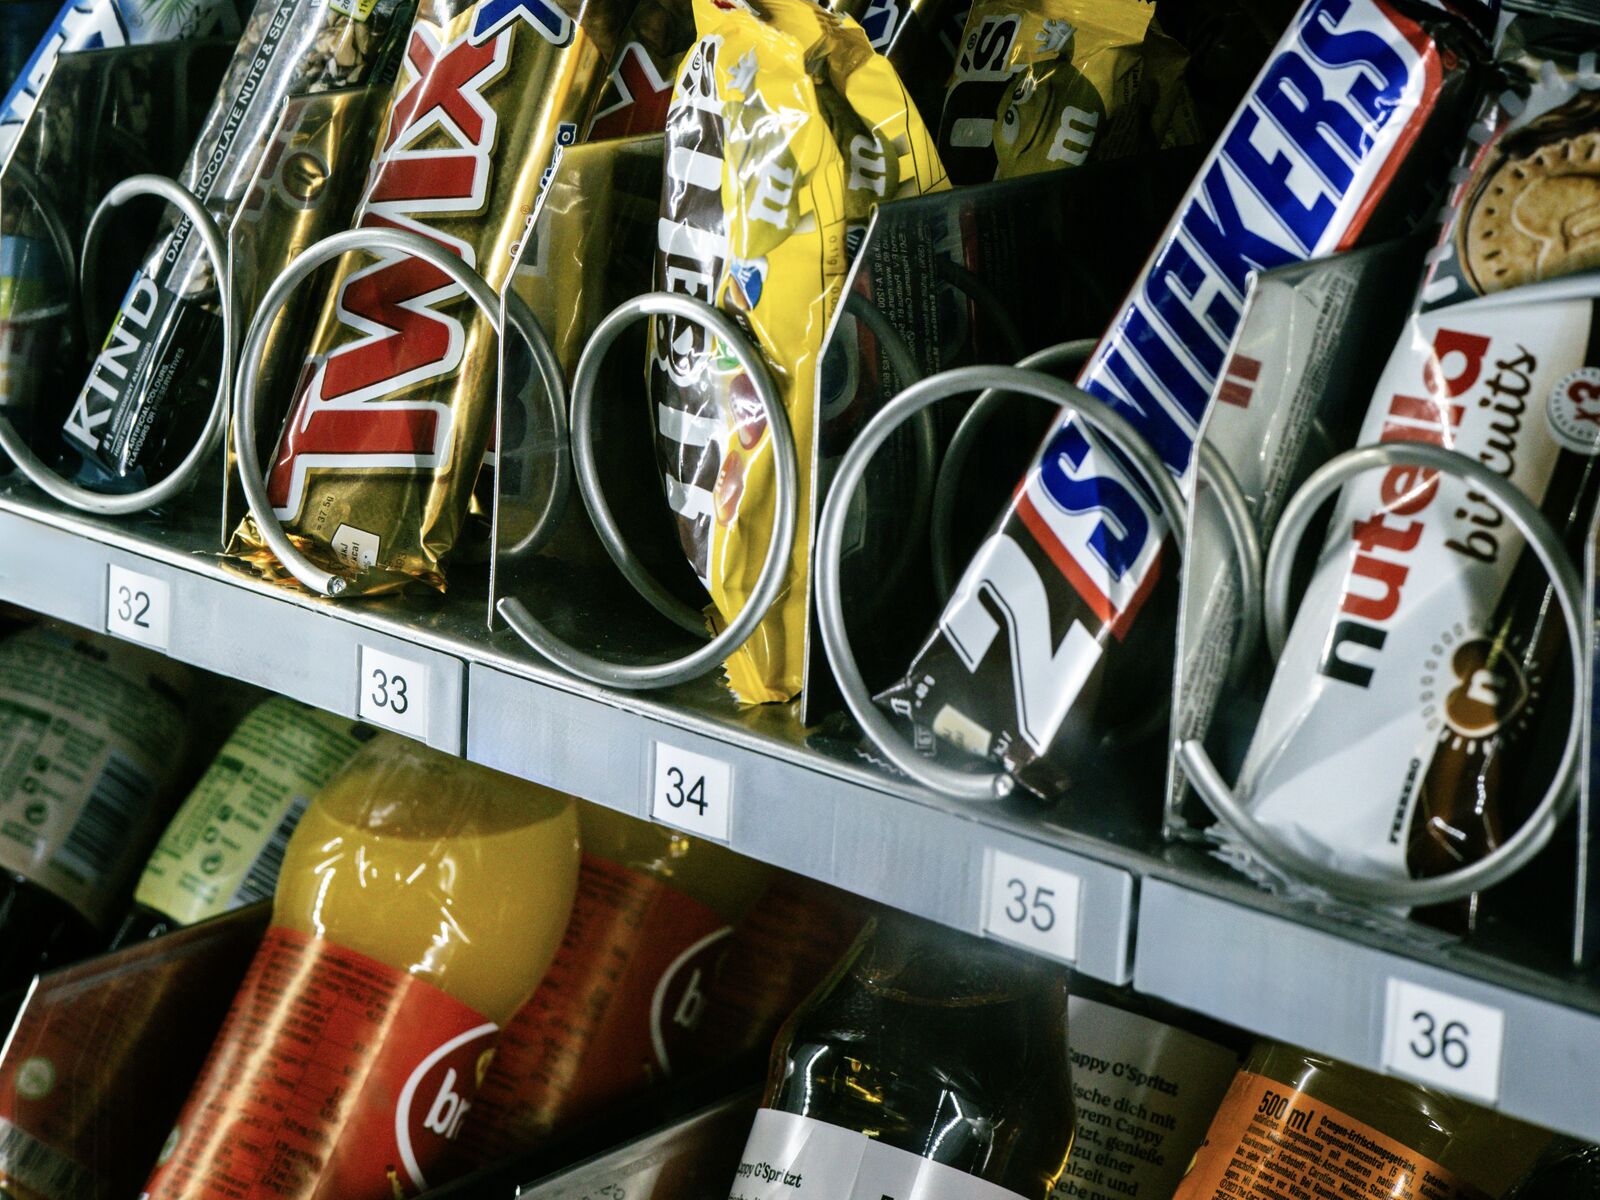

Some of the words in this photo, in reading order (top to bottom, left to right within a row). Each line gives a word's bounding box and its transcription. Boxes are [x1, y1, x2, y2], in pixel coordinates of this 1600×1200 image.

[267, 5, 293, 39] SEA
[261, 40, 275, 56] &
[238, 57, 267, 107] NUTS
[195, 108, 244, 201] HOCOLATE
[165, 213, 191, 264] DARK
[265, 28, 505, 518] TWIX
[64, 277, 159, 451] KIND
[111, 383, 135, 434] INGREDIENT
[1445, 344, 1538, 565] bicuits
[1320, 328, 1491, 688] nutella
[119, 592, 151, 629] 32
[939, 533, 1103, 757] 2
[372, 669, 409, 714] 33
[666, 767, 709, 817] 34
[1005, 879, 1055, 932] 35
[1409, 1011, 1470, 1070] 36
[1114, 1097, 1148, 1120] dich
[1150, 1110, 1177, 1131] mit
[1115, 1118, 1164, 1148] Cappy
[1258, 1090, 1290, 1120] 500
[1287, 1108, 1315, 1133] ml
[1094, 1151, 1136, 1176] einer
[1106, 1176, 1139, 1197] und
